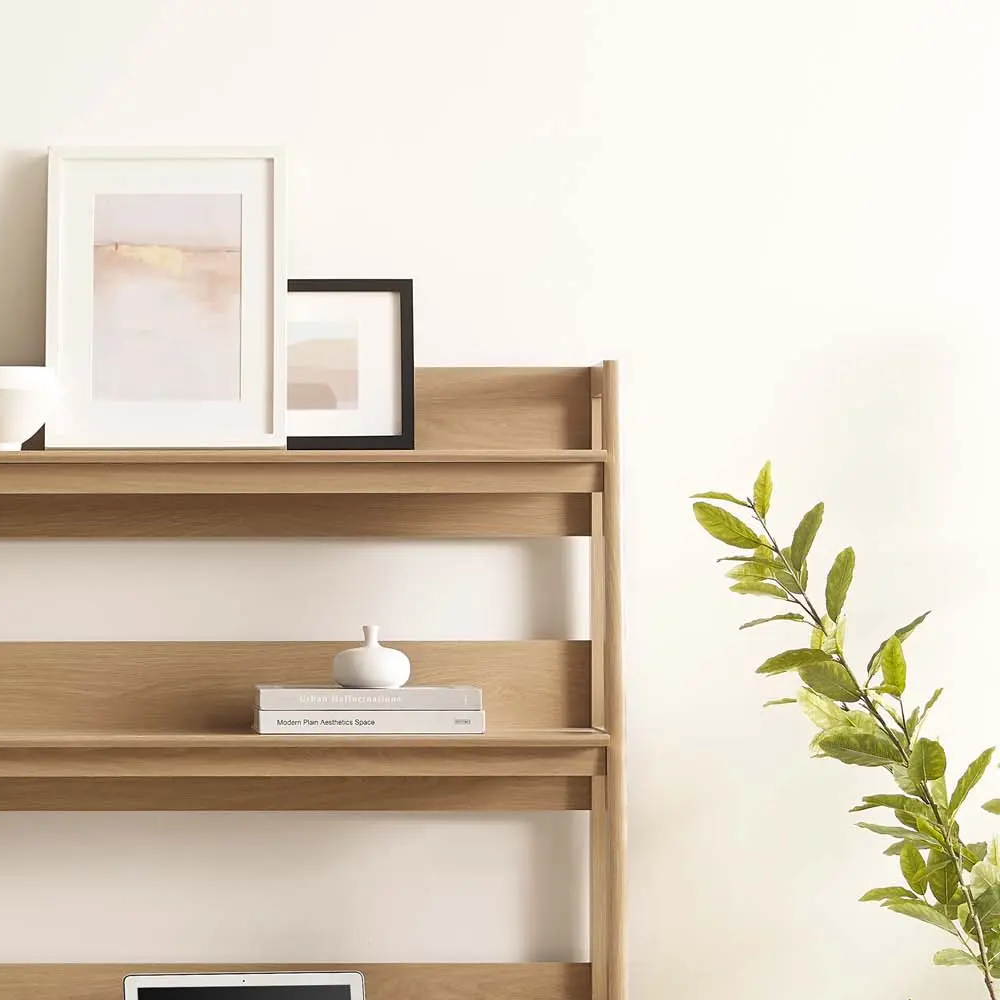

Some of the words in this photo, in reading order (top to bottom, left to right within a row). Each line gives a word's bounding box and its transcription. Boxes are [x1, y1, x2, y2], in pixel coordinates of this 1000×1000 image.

[276, 719, 302, 727] Modern
[303, 719, 319, 727] Plain
[320, 719, 353, 727] Aesthetics
[354, 719, 376, 728] Space
